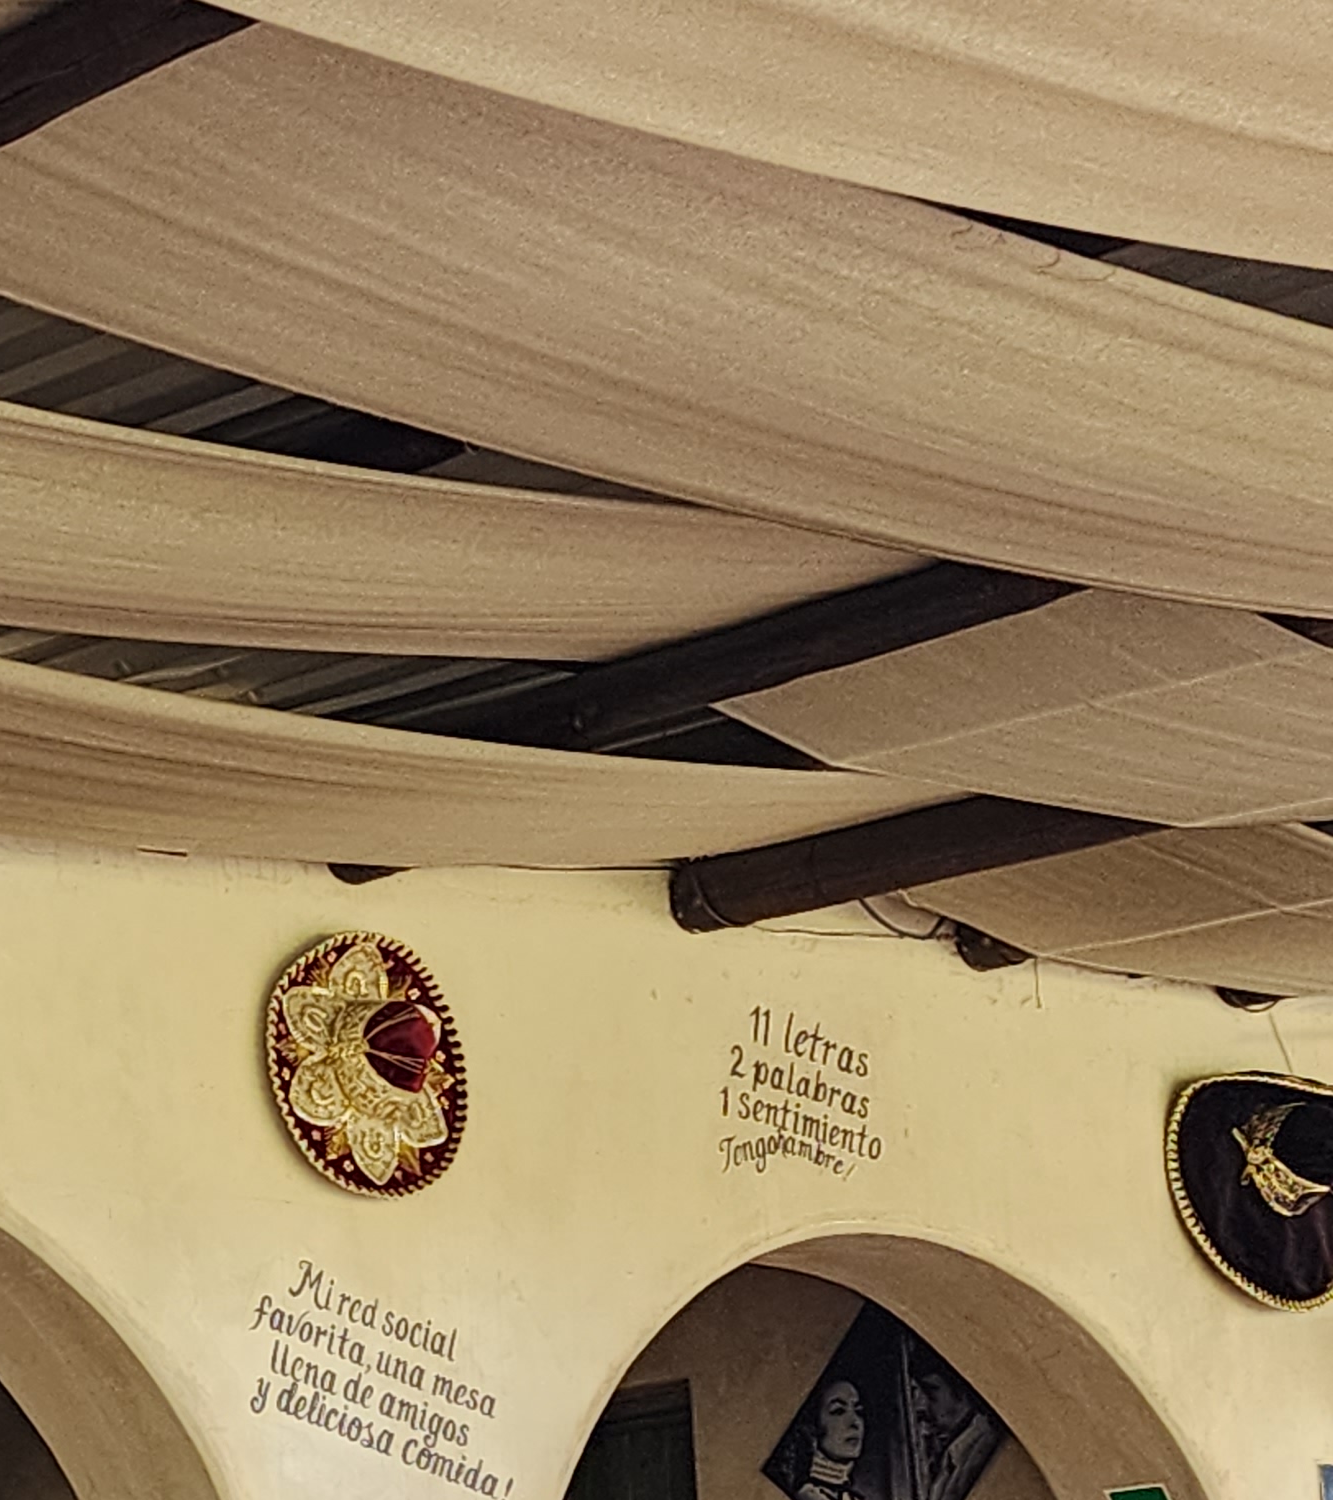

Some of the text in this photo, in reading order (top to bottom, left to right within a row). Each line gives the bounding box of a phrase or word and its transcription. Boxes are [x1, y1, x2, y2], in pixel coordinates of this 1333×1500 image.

[730, 1044, 871, 1120] 2 palabras
[748, 1005, 870, 1078] 11 letras
[719, 1086, 729, 1117] 1
[288, 1259, 459, 1363] Mi red social
[248, 1294, 497, 1420] favorita, una mesa
[269, 1338, 472, 1448] llena de amigos
[250, 1376, 272, 1415] y
[276, 1381, 396, 1457] deliciosa
